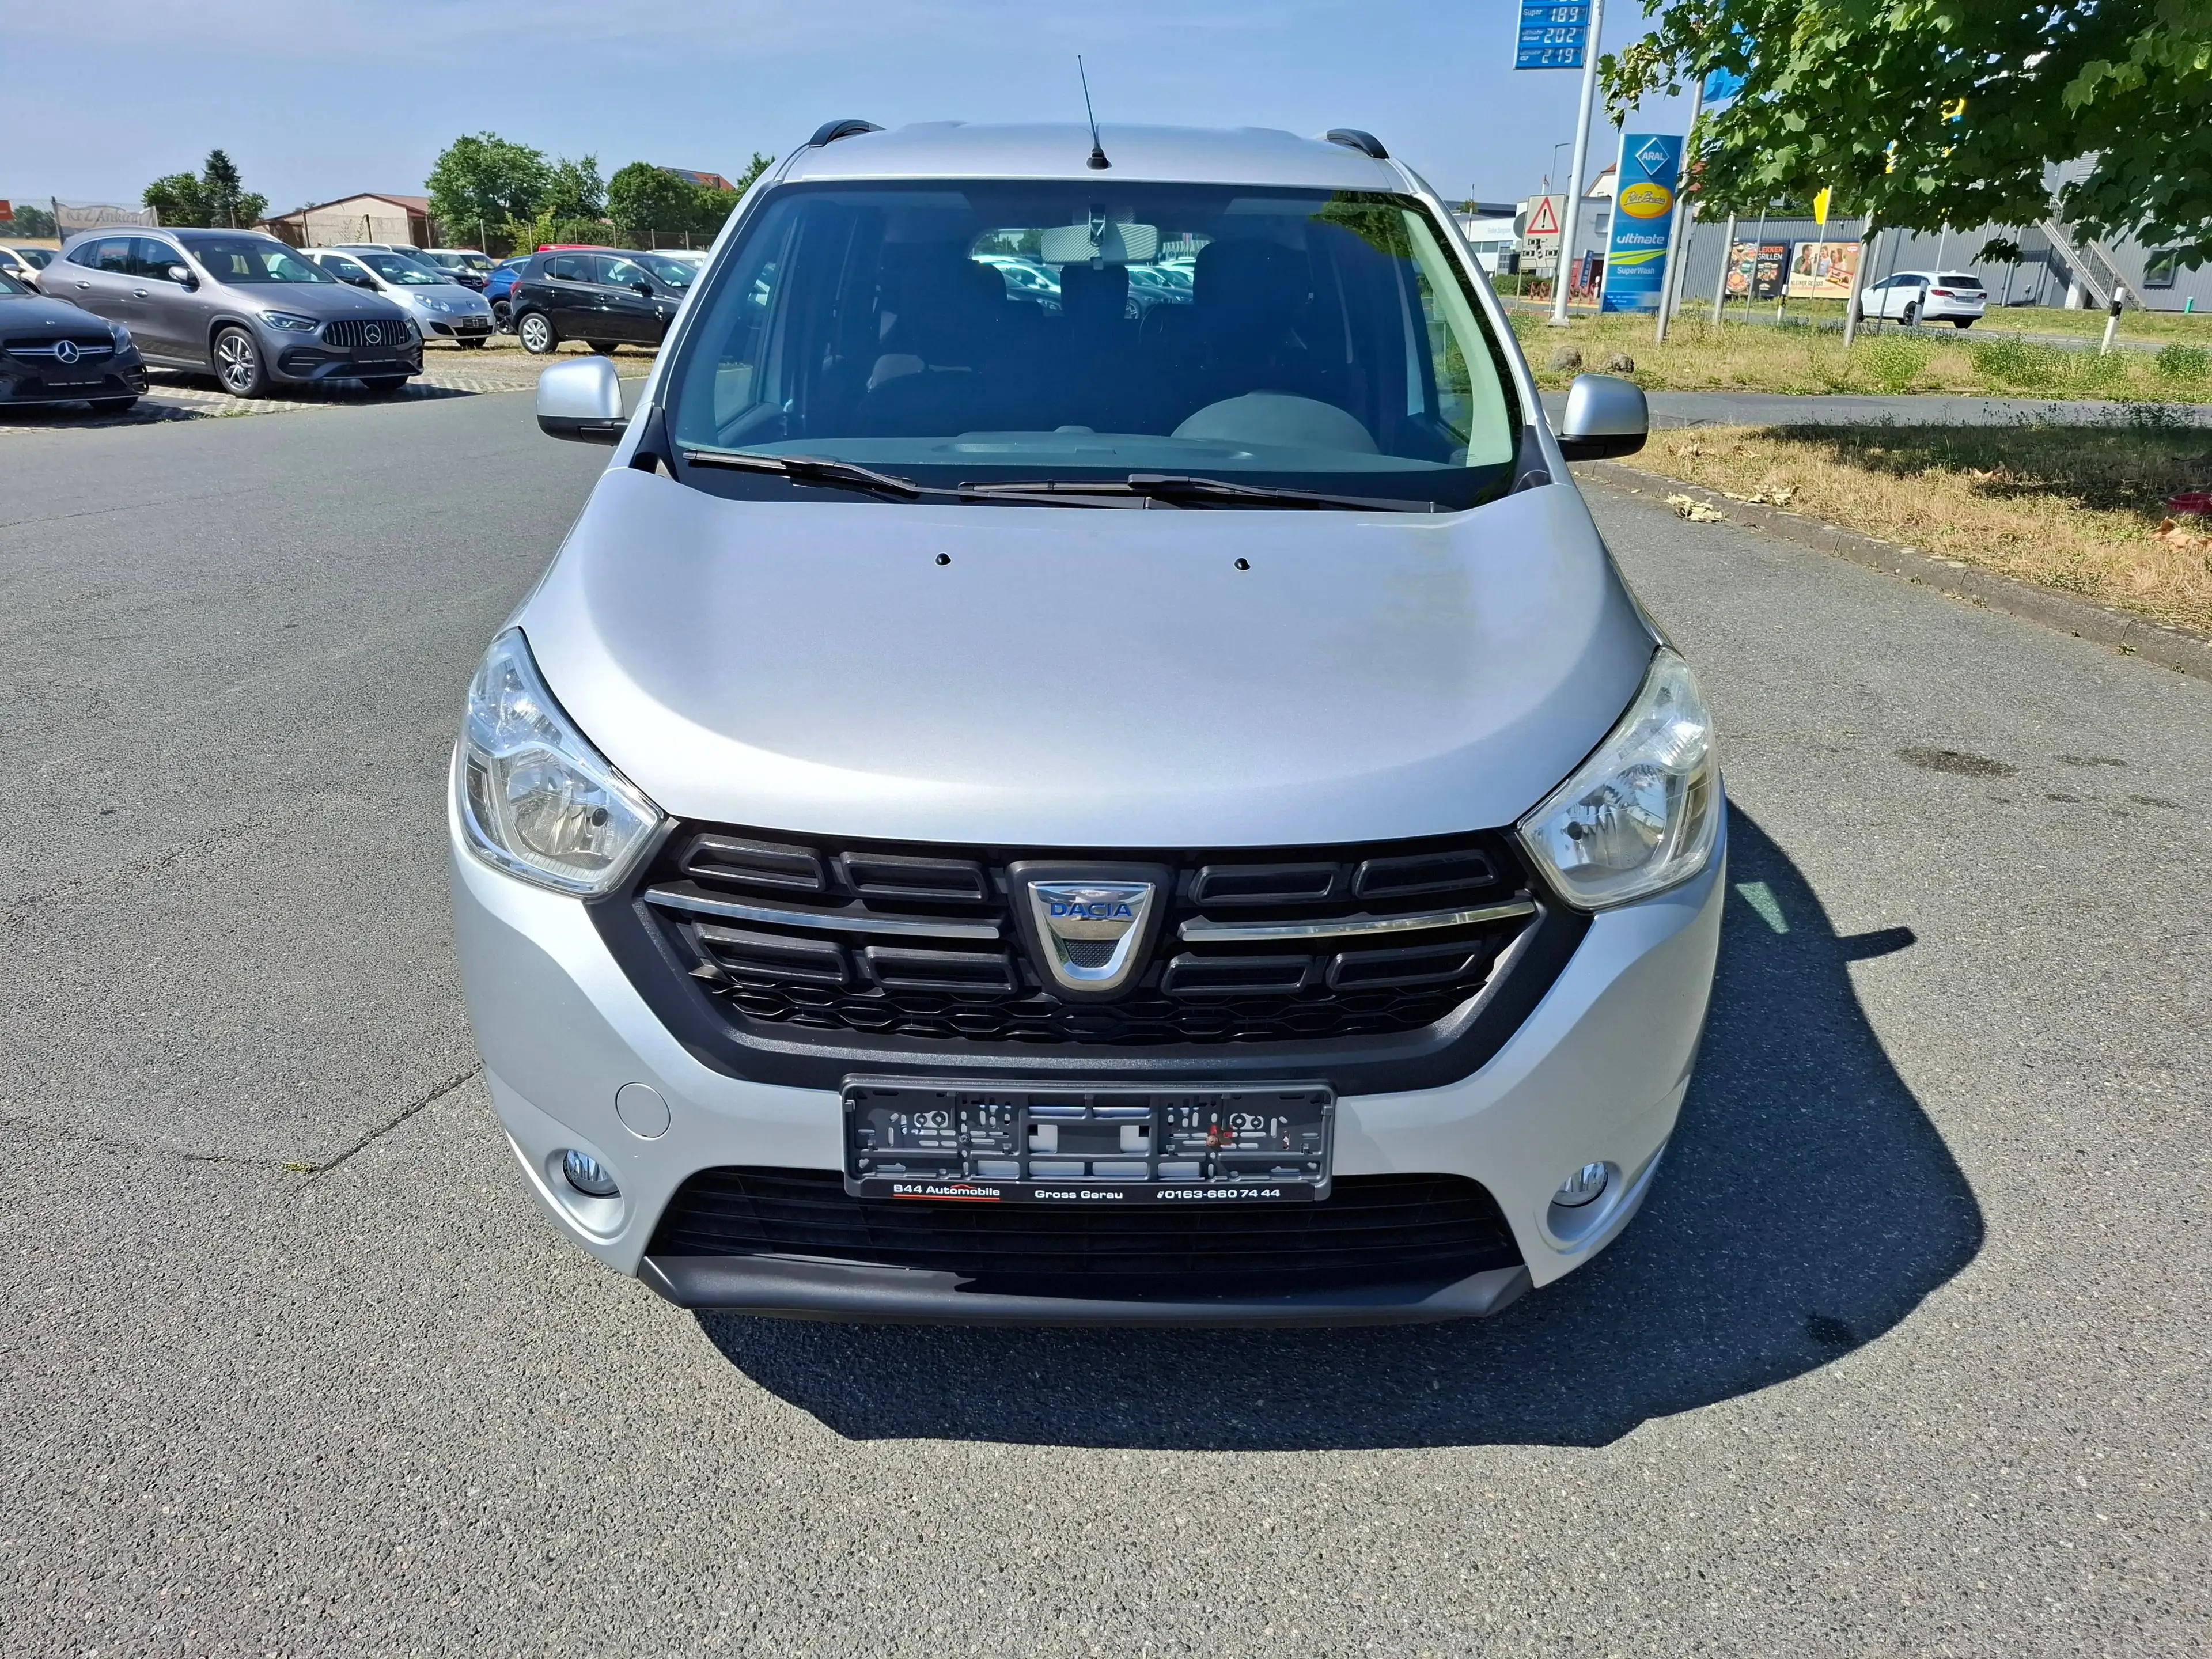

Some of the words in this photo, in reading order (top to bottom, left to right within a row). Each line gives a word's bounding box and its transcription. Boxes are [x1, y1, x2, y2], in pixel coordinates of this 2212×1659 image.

[1551, 7, 1578, 22] 189
[1544, 27, 1576, 43] 202
[1541, 48, 1573, 63] 219
[1642, 151, 1664, 161] ARAL
[1616, 233, 1665, 244] ultimate
[1616, 267, 1655, 275] SuperWash
[1050, 902, 1132, 917] DACIA
[893, 1184, 922, 1193] B44
[926, 1185, 1000, 1196] Automobile
[1035, 1190, 1077, 1199] Gross
[1081, 1190, 1123, 1199] Gerau
[1165, 1190, 1237, 1199] 0163-660
